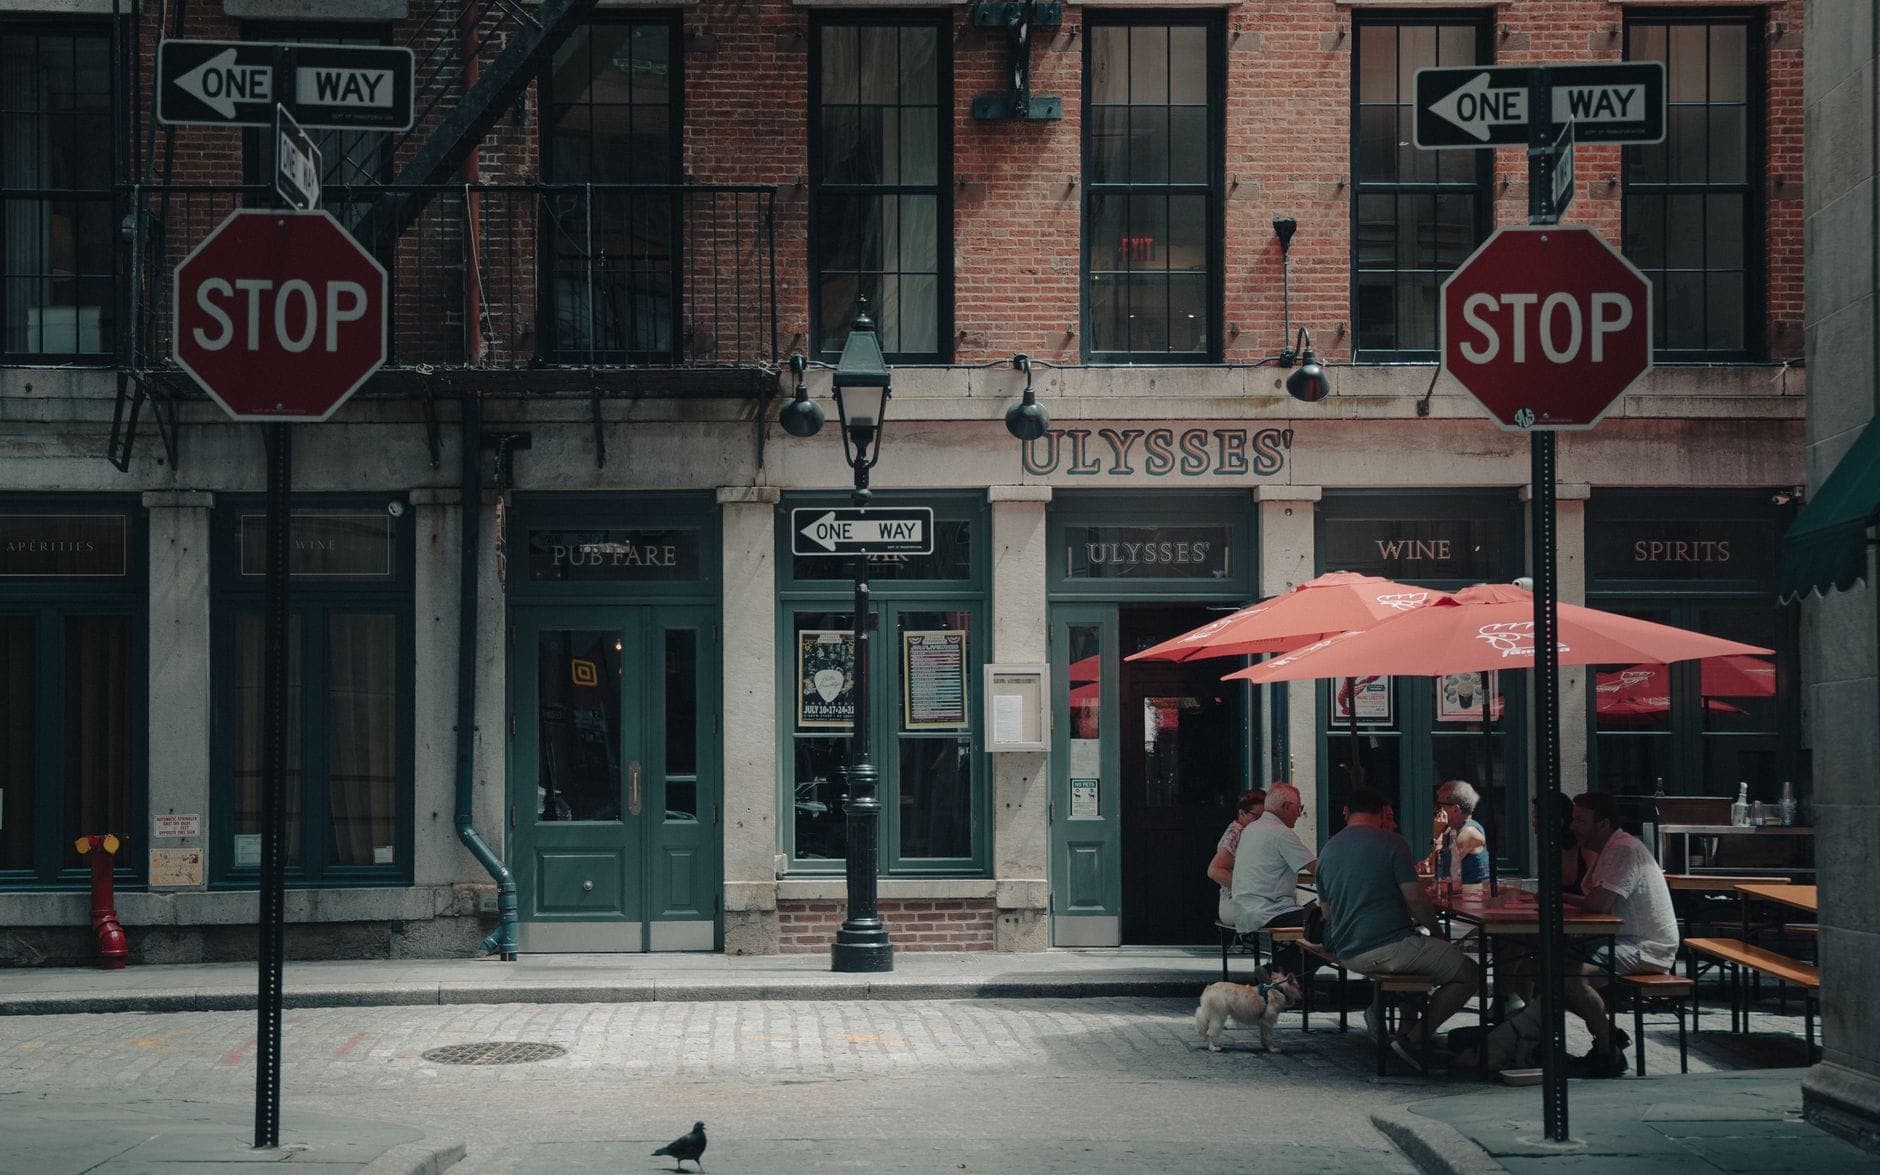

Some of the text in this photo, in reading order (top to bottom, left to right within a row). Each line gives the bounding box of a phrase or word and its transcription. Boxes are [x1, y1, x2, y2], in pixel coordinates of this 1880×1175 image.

[202, 68, 384, 102] ONE WAY
[1457, 88, 1637, 122] ONE WAY
[1121, 237, 1153, 262] EXIT
[192, 277, 368, 352] STOP
[1458, 291, 1633, 365] STOP
[1022, 429, 1294, 476] ULYSSES'
[817, 522, 916, 540] ONE WAY
[295, 540, 336, 551] WINE
[552, 545, 677, 566] PUB FARE
[1086, 542, 1210, 564] ULYSSES'
[1375, 539, 1451, 560] WINE
[1634, 540, 1730, 561] SPIRITS
[804, 705, 819, 714] JULY
